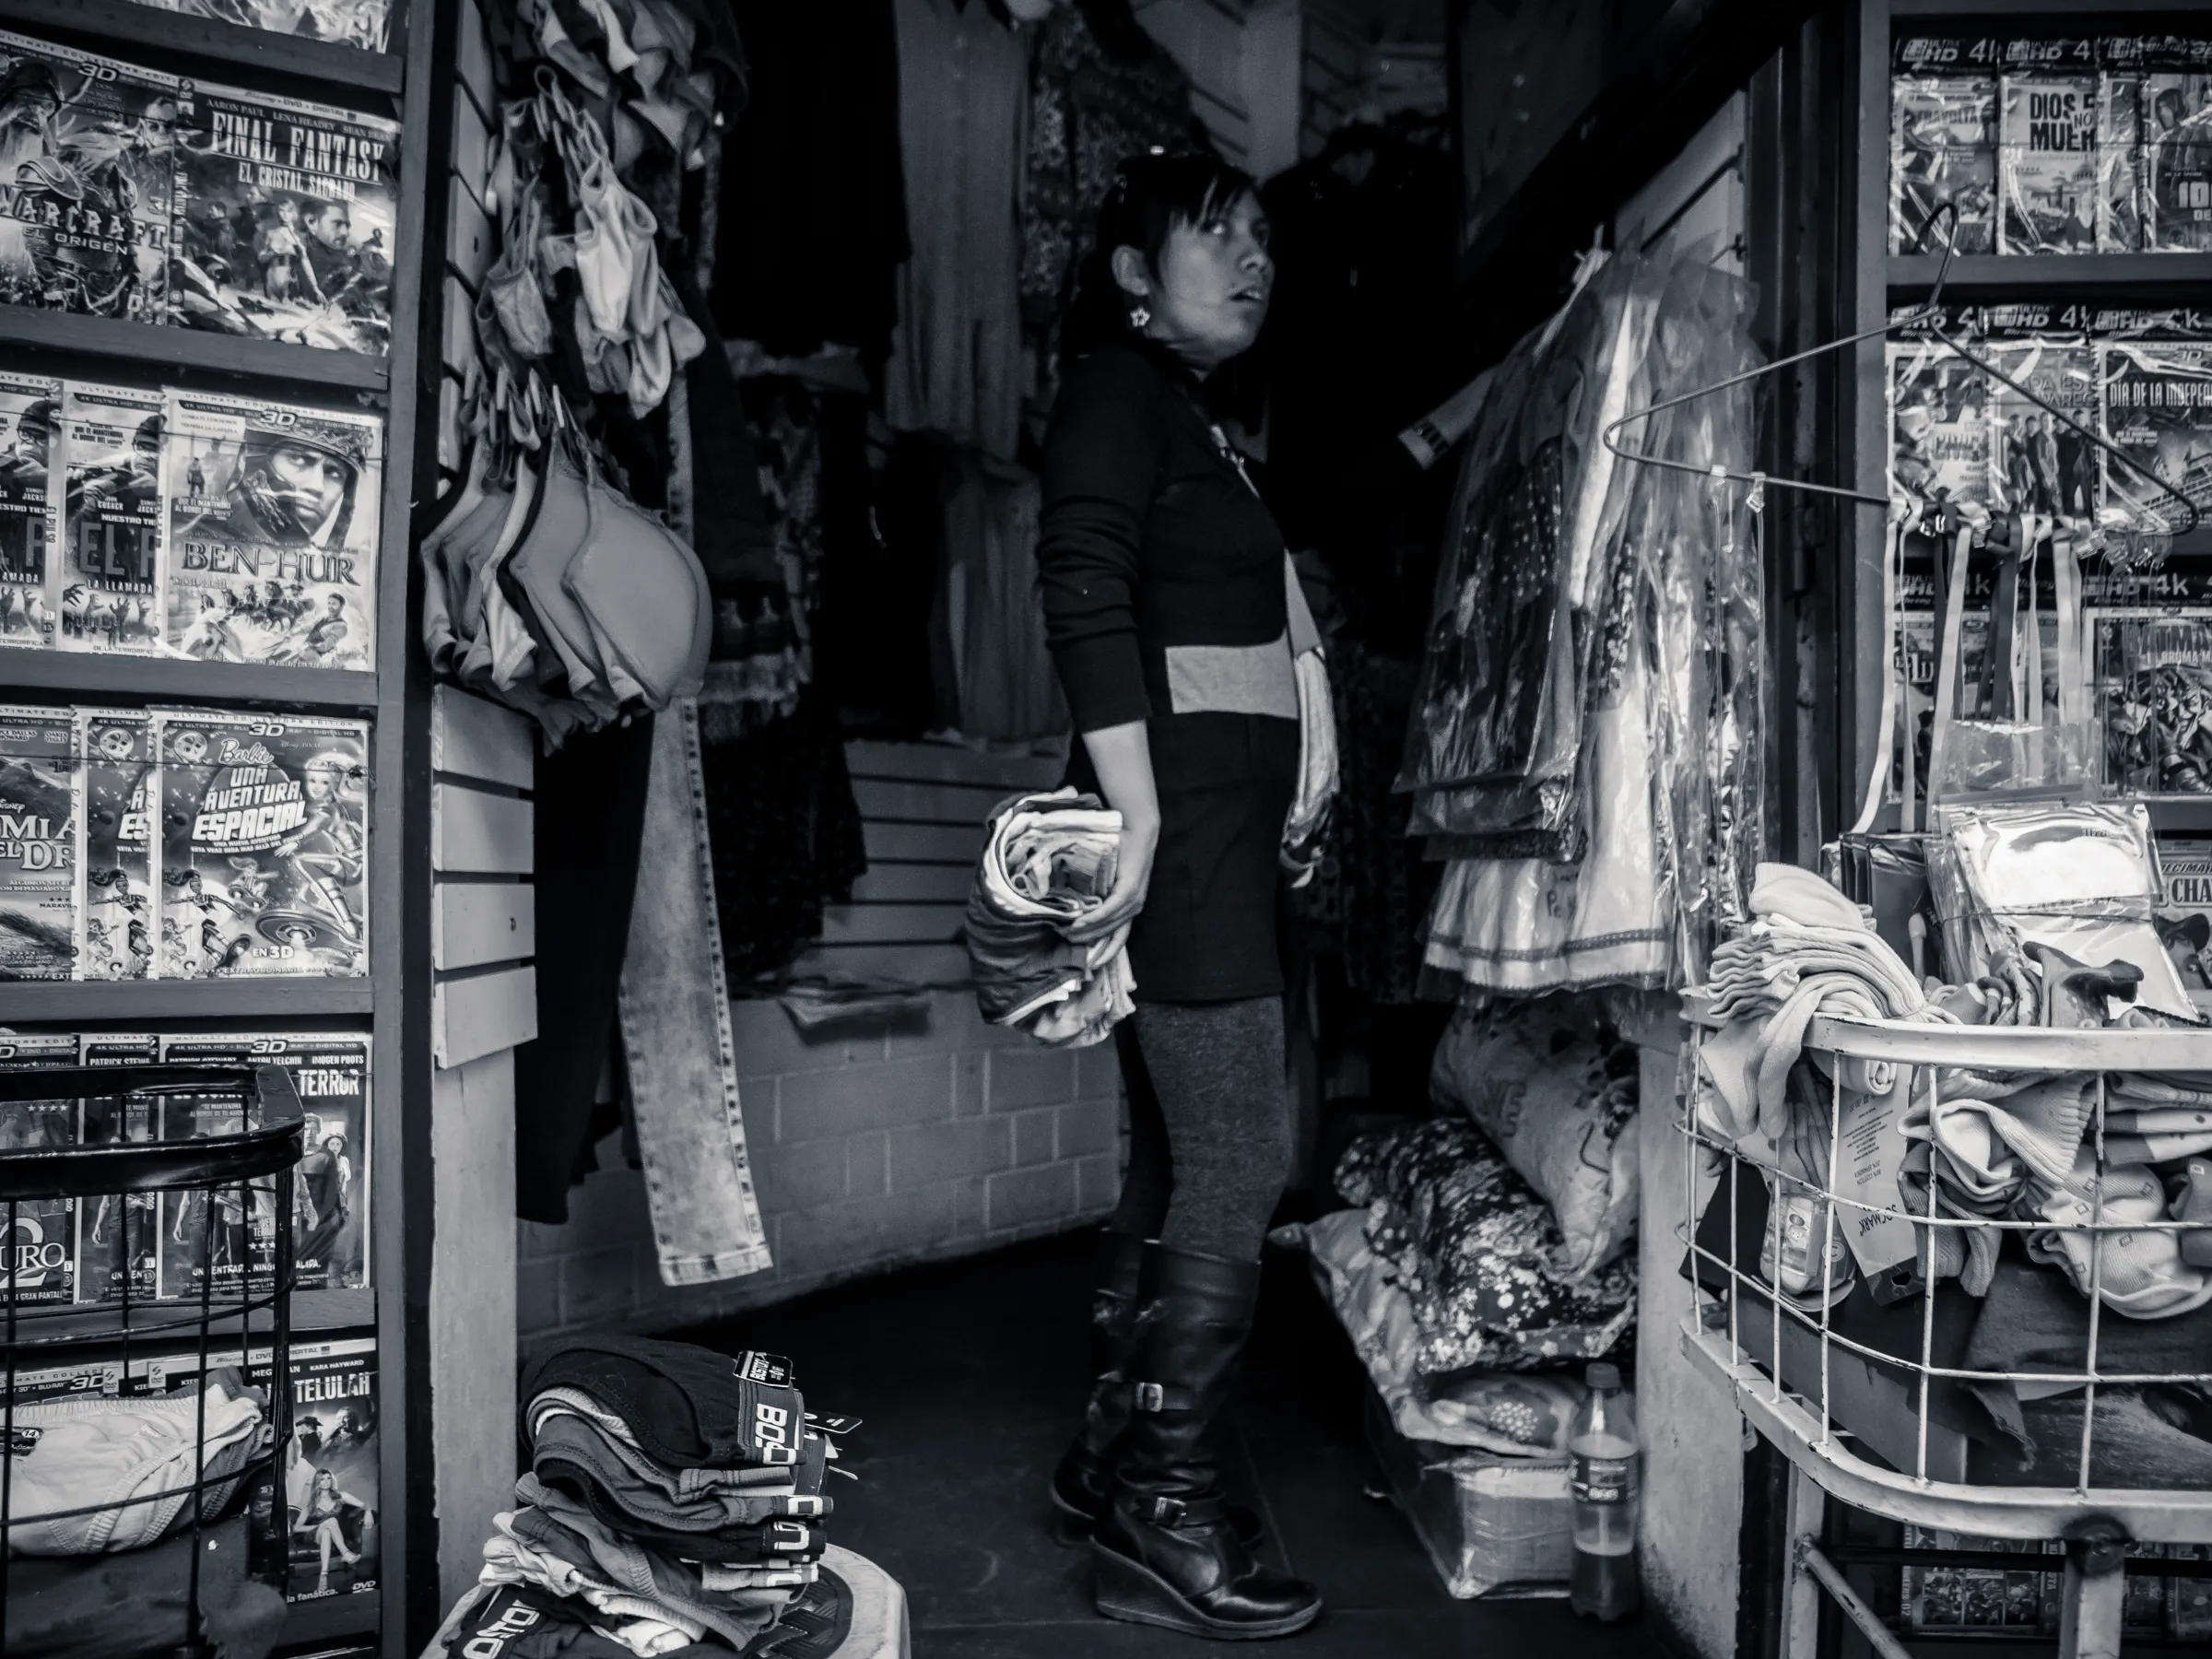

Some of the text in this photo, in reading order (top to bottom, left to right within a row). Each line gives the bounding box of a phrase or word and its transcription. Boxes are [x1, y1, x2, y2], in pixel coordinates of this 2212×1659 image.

[78, 61, 117, 82] 3D
[206, 99, 265, 118] AARON PAUL
[2030, 92, 2076, 121] DIOS
[273, 112, 295, 124] LENA
[212, 111, 385, 182] FINAL FANTASY
[239, 161, 253, 183] EL
[258, 166, 302, 194] CRISTAL
[23, 227, 128, 255] EL ORIGEN
[2133, 382, 2147, 407] DE
[2149, 382, 2163, 407] LA
[260, 410, 296, 426] 3D
[101, 513, 142, 525] NUESTRO
[79, 521, 125, 576] EL
[181, 541, 361, 586] BEN-HUR
[88, 579, 153, 594] LA LLAMADA
[249, 724, 284, 736] 3D
[218, 737, 275, 764] Barbie
[230, 764, 267, 787] UNA
[203, 780, 301, 812] AVENTURA
[192, 800, 307, 841] ESPACIAL
[228, 839, 250, 847] NUEVA
[253, 945, 294, 959] EN 3D
[224, 967, 304, 975] EXTRAORDINARIA
[251, 1040, 287, 1054] 3D
[89, 1057, 122, 1066] PATRICK
[312, 1054, 364, 1065] IMOGEN POOTS
[298, 1069, 359, 1097] TERROR
[310, 1359, 365, 1372] KARA HAYWARD
[352, 1580, 376, 1591] DVD
